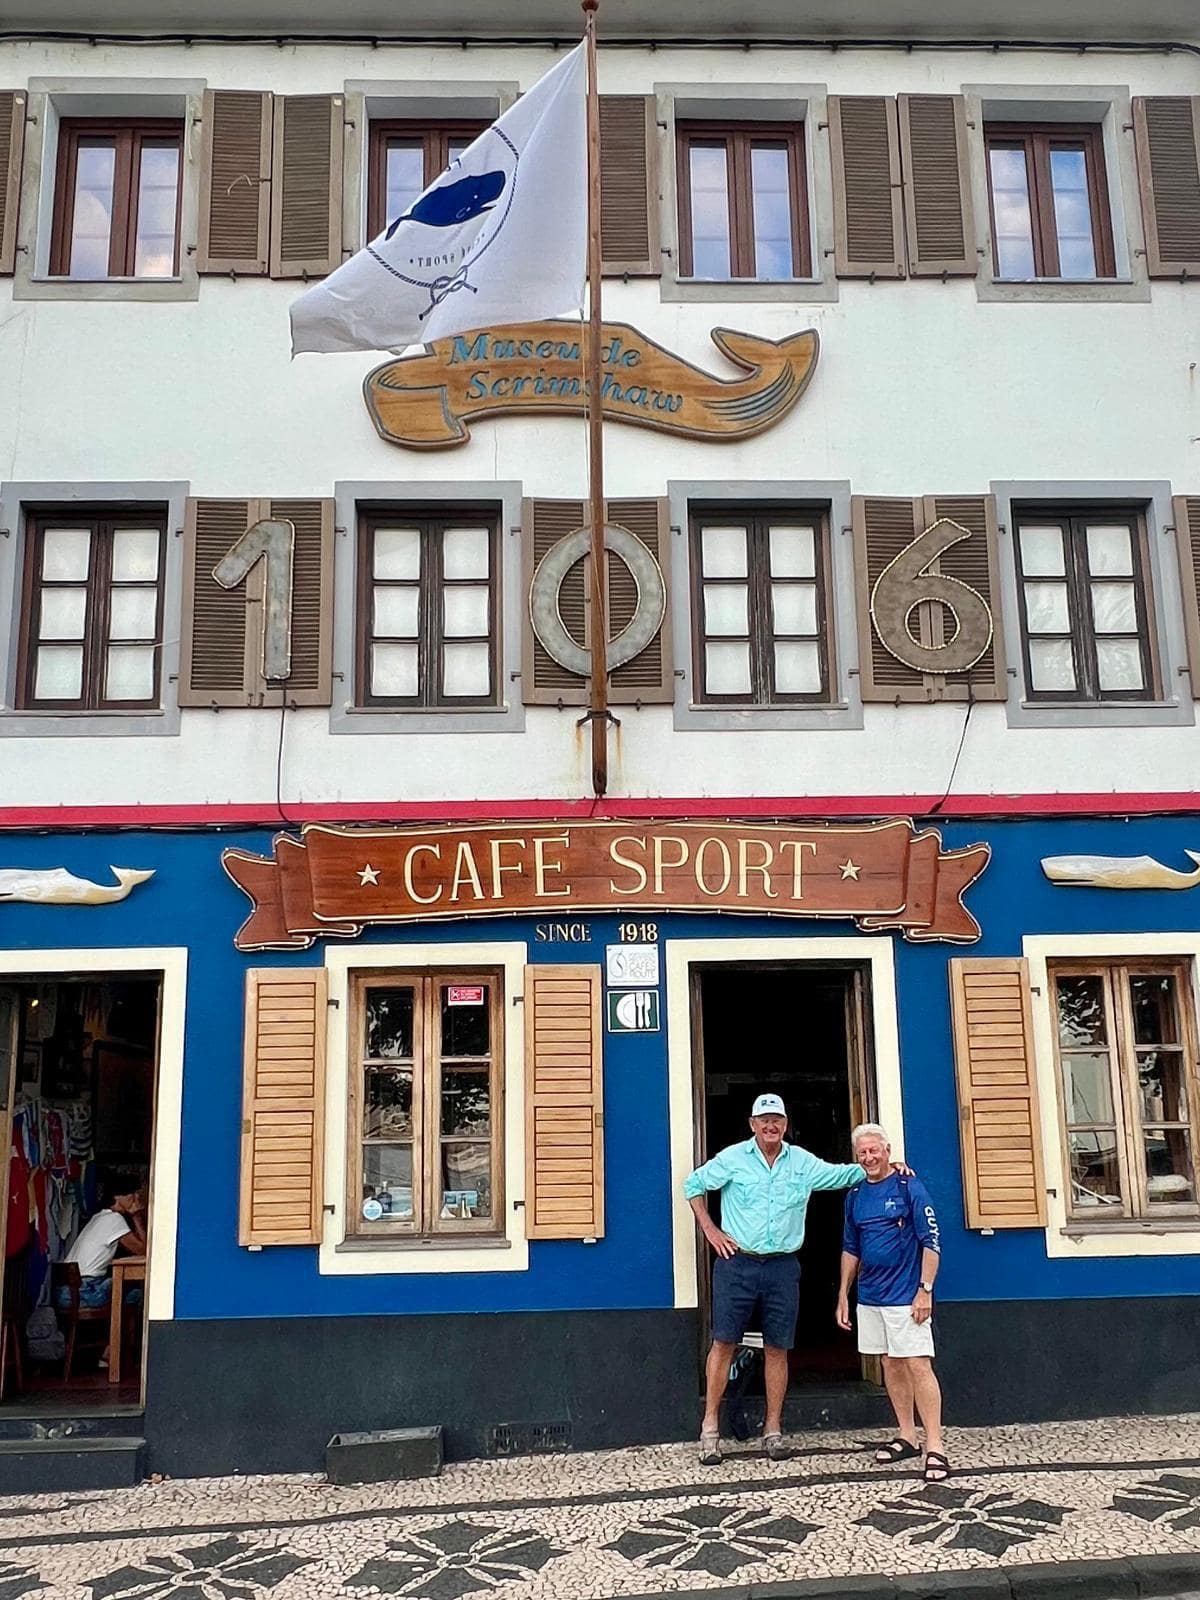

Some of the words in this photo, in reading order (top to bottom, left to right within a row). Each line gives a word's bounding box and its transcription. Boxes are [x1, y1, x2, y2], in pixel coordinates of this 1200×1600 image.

[446, 332, 582, 367] Museu
[601, 337, 641, 368] de
[404, 830, 571, 904] CAFÉ
[610, 836, 817, 899] SPORT
[535, 923, 592, 942] SINCE
[618, 923, 658, 942] 1918
